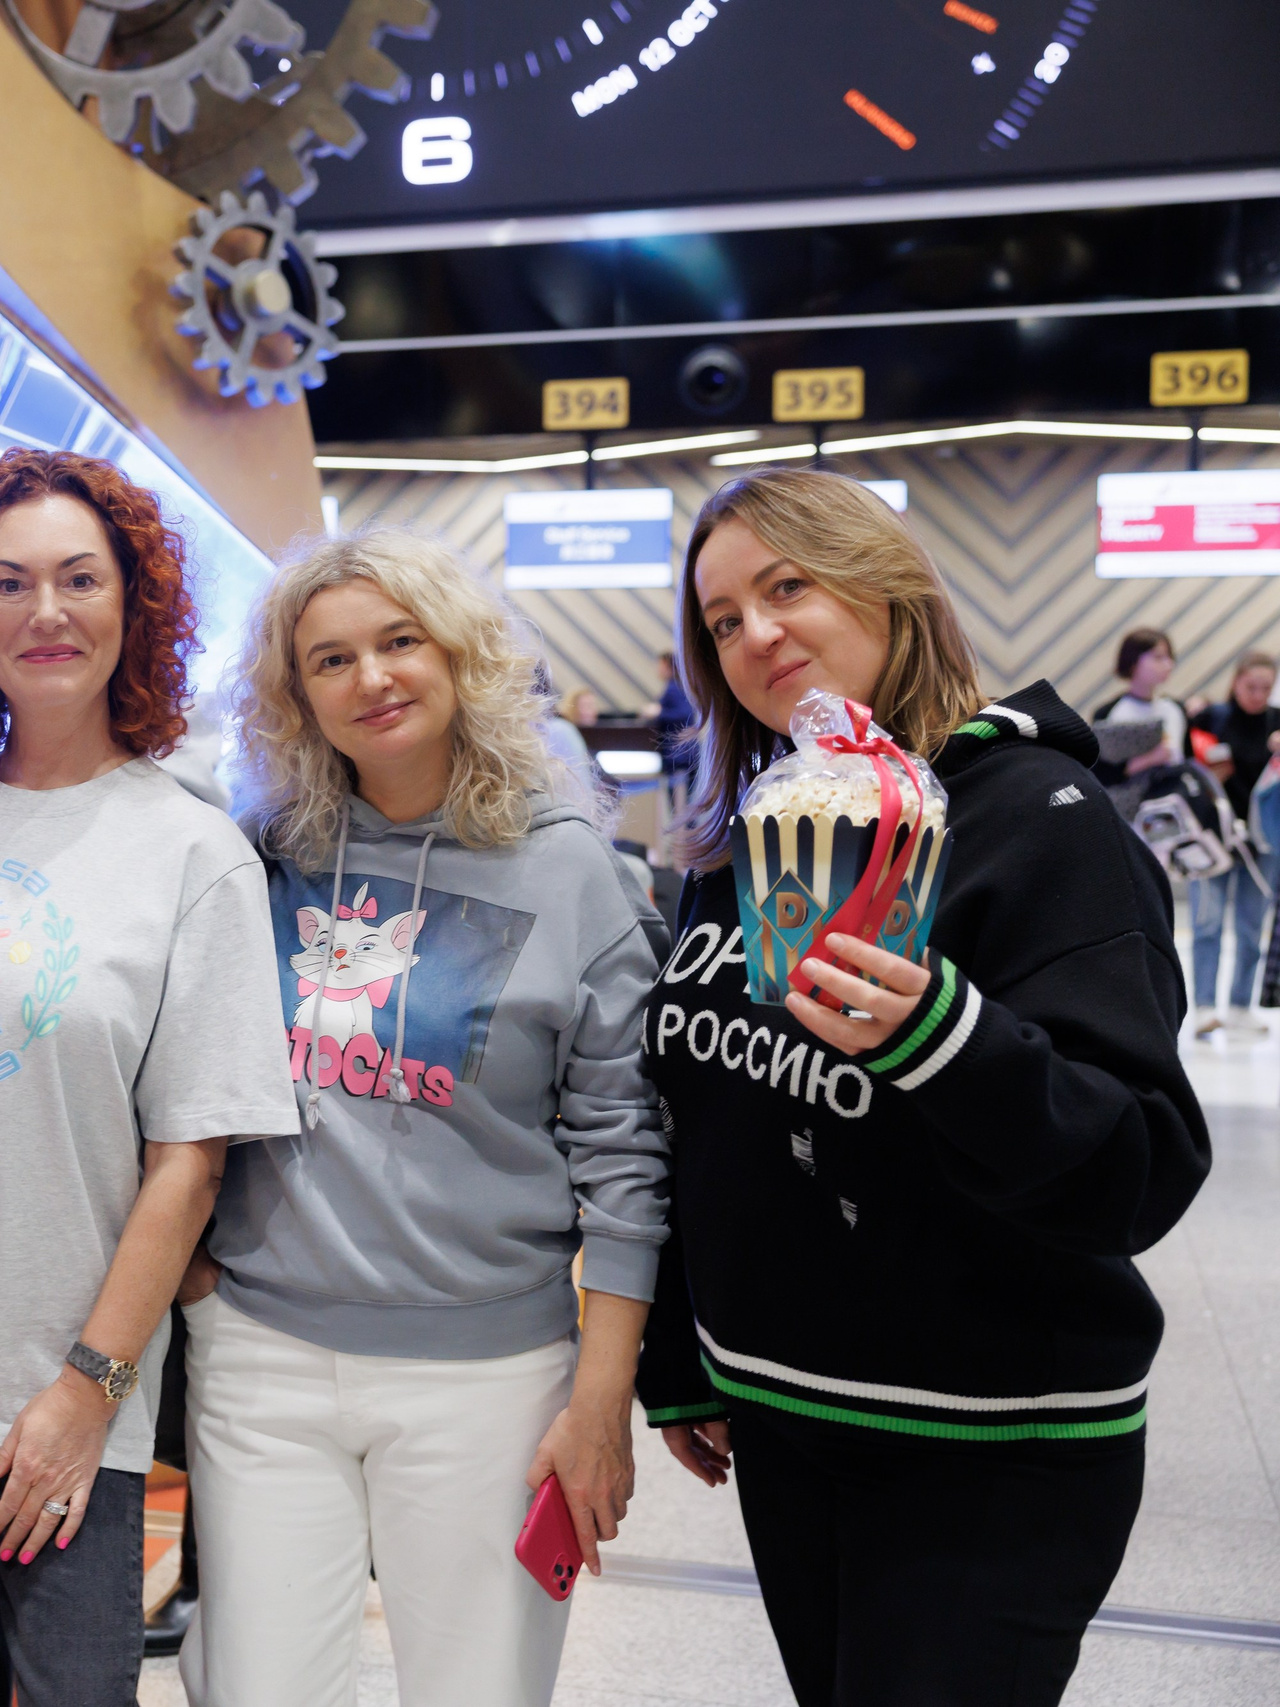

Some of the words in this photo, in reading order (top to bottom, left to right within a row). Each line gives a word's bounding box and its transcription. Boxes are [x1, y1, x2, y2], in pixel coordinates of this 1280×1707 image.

[402, 117, 472, 185] 6
[784, 378, 855, 412] 395
[1159, 360, 1239, 396] 396
[552, 388, 619, 420] 394
[776, 892, 808, 928] D
[884, 900, 910, 936] D
[285, 1026, 454, 1107] TOCATS
[658, 1004, 873, 1118] РОССИЮ
